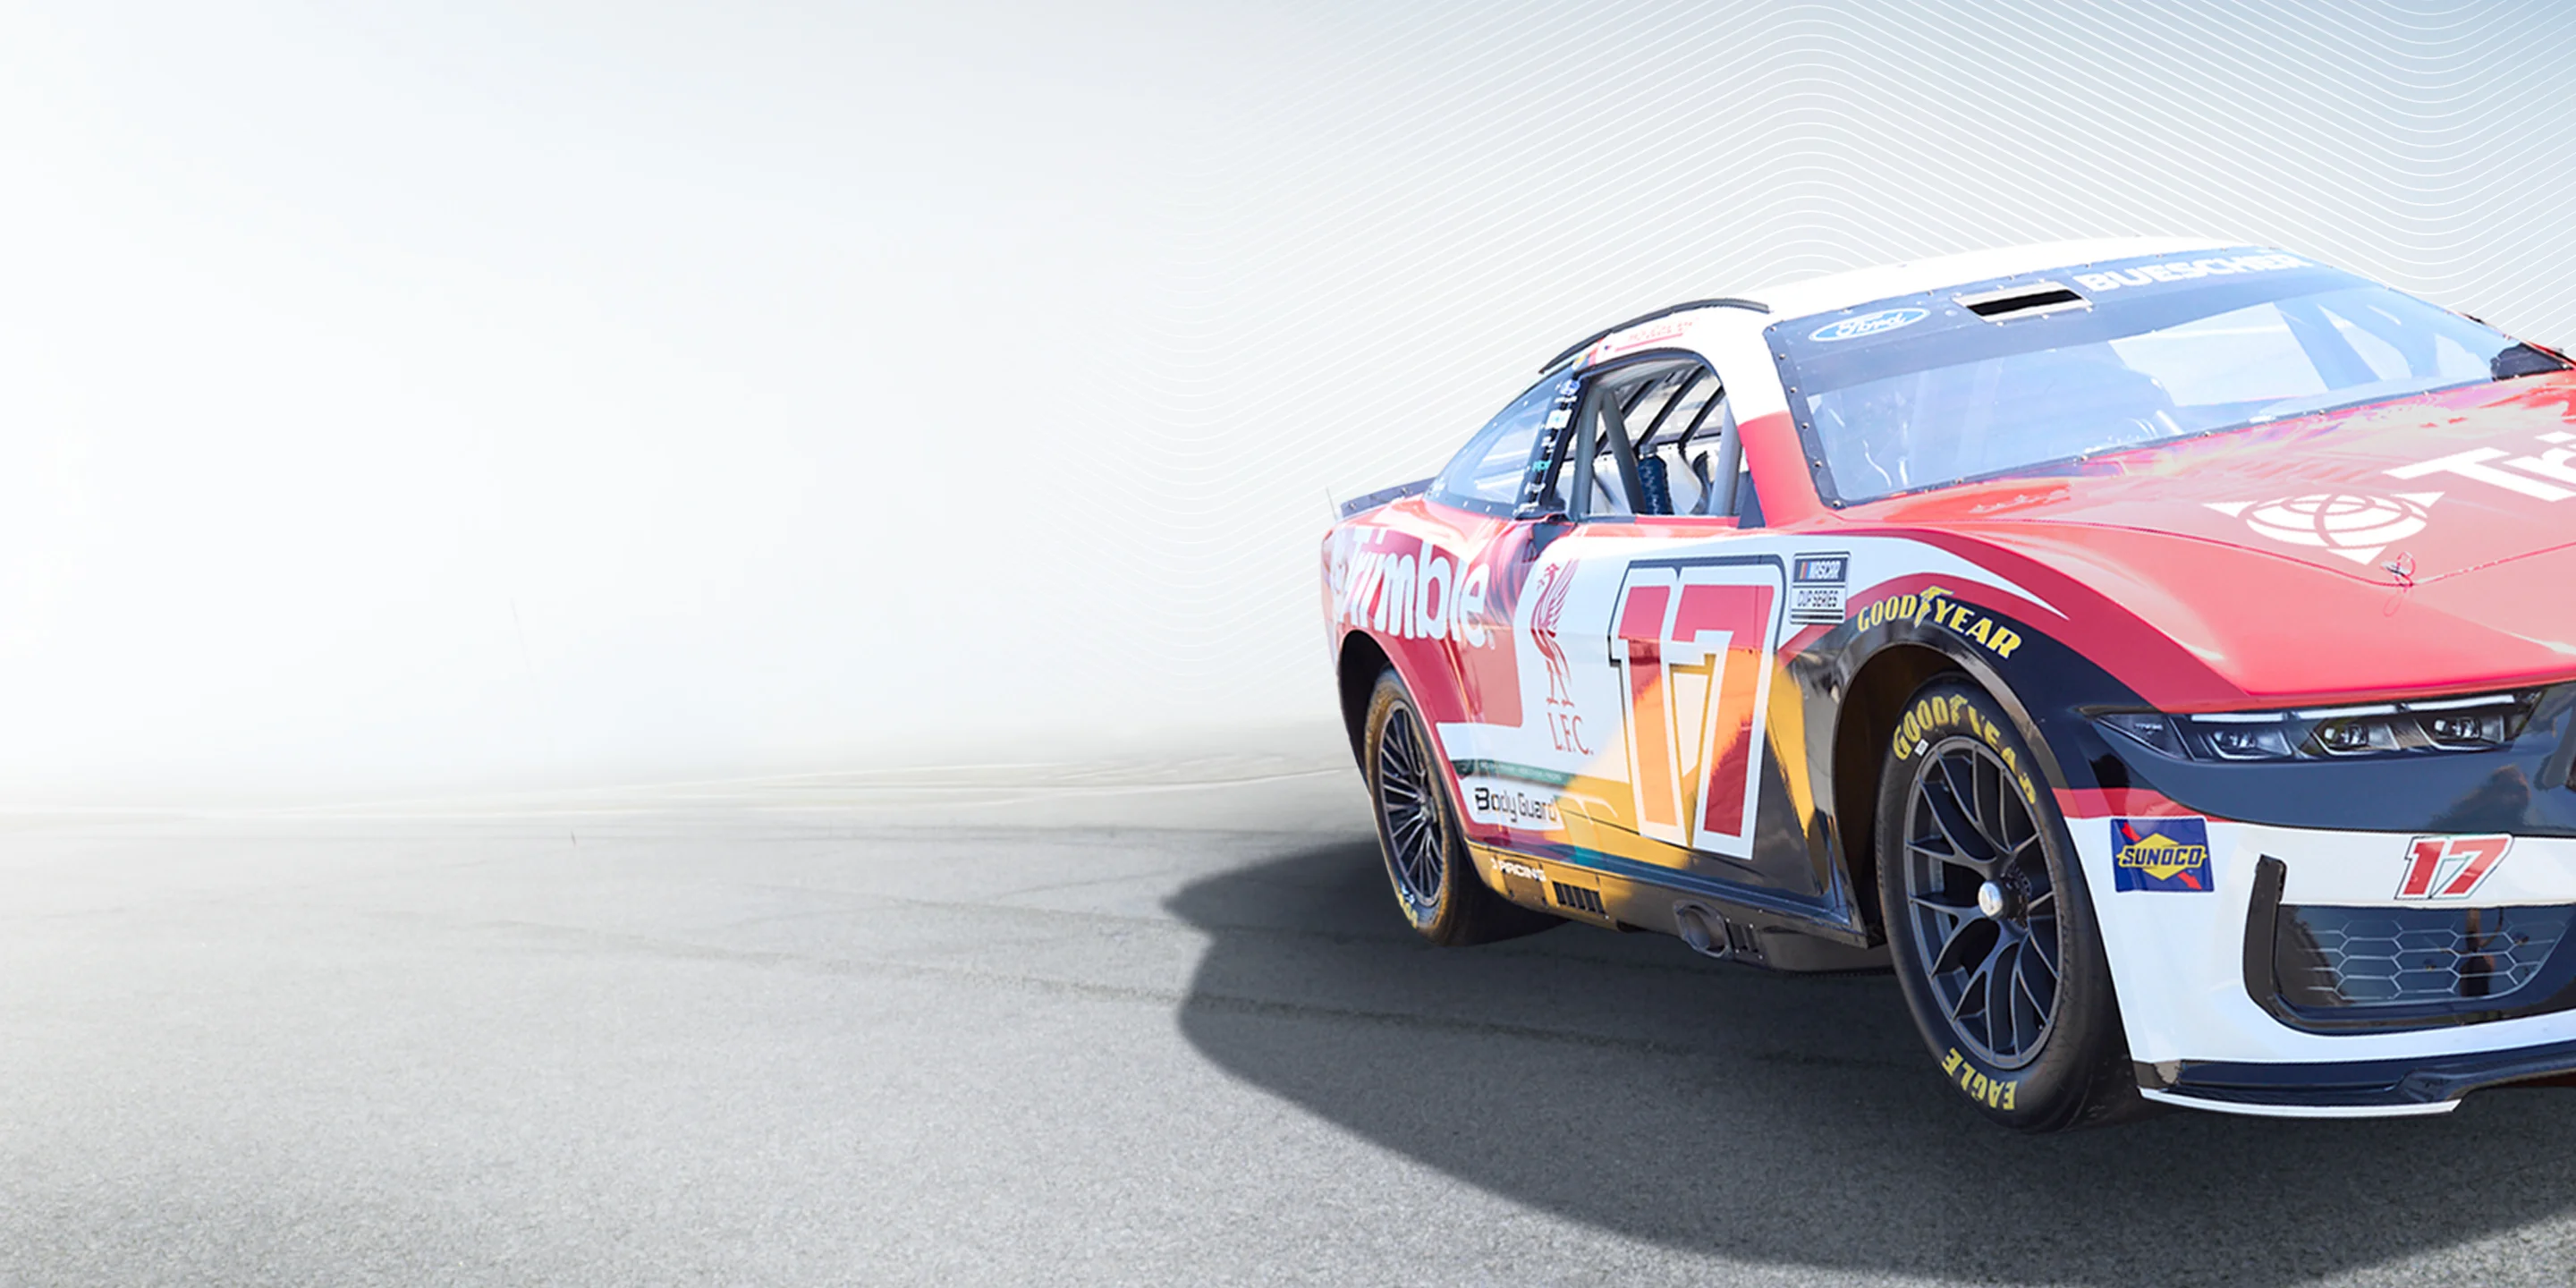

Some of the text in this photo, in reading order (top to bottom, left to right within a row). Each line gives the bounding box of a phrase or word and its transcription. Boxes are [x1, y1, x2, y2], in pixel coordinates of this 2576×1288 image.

[2072, 253, 2316, 292] BUESCHER
[1835, 312, 1908, 337] Ford
[1338, 525, 1491, 648] Trimble
[1609, 556, 1784, 859] 17
[2121, 847, 2203, 867] SUNOCO
[2396, 835, 2514, 899] 17
[1941, 1047, 2019, 1110] EAGLE
